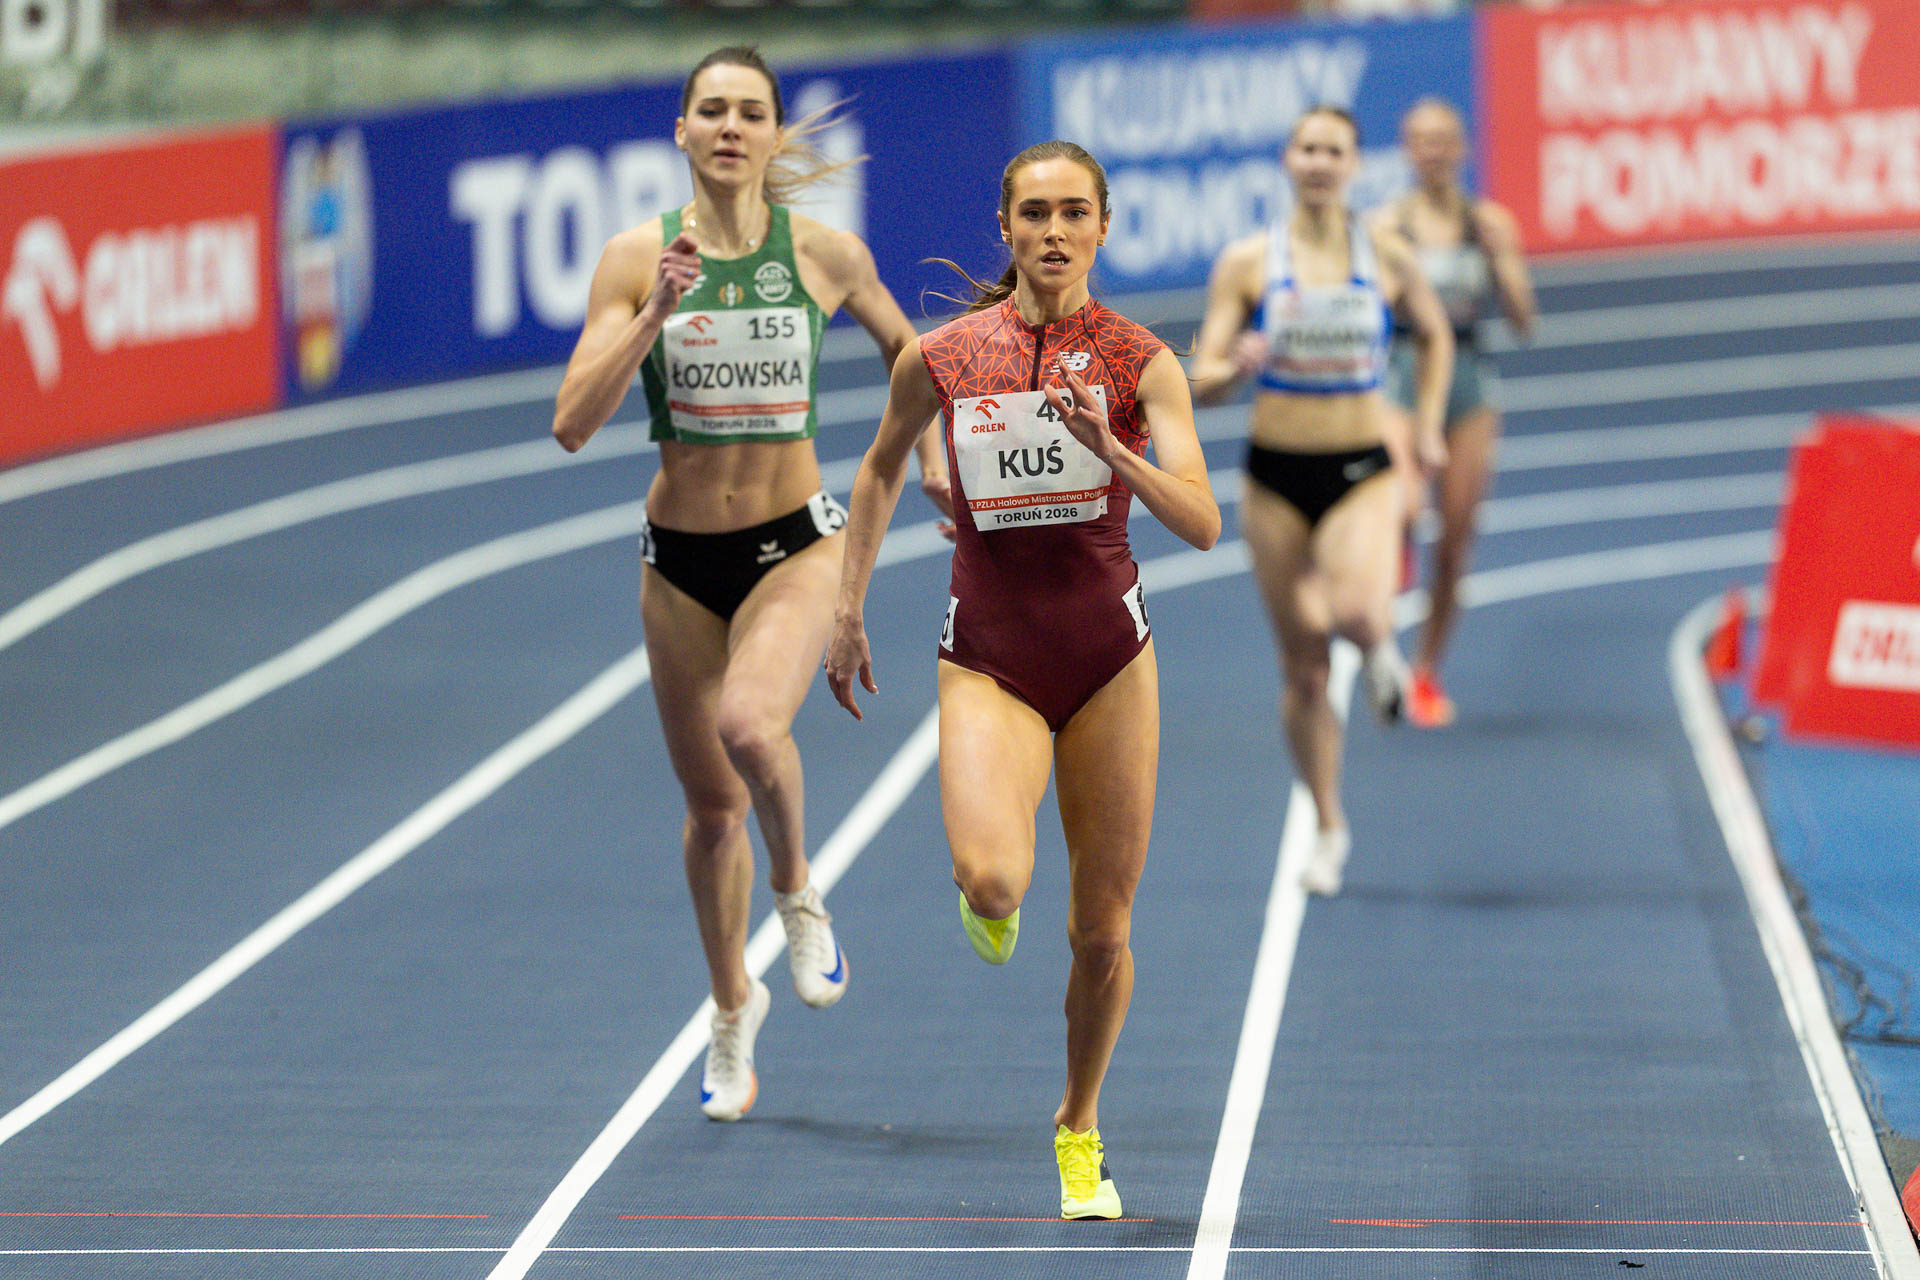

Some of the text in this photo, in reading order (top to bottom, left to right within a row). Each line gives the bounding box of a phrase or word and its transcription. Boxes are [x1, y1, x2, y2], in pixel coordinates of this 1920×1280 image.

[748, 316, 795, 340] 155
[672, 360, 803, 389] ŁOZOWSKA
[971, 422, 1006, 434] ORLEN
[998, 439, 1065, 479] KUŚ
[976, 500, 996, 509] PZLA
[997, 498, 1030, 507] Halowe
[1031, 494, 1083, 505] Mistrzostwa
[994, 507, 1078, 524] TORUŃ 2026
